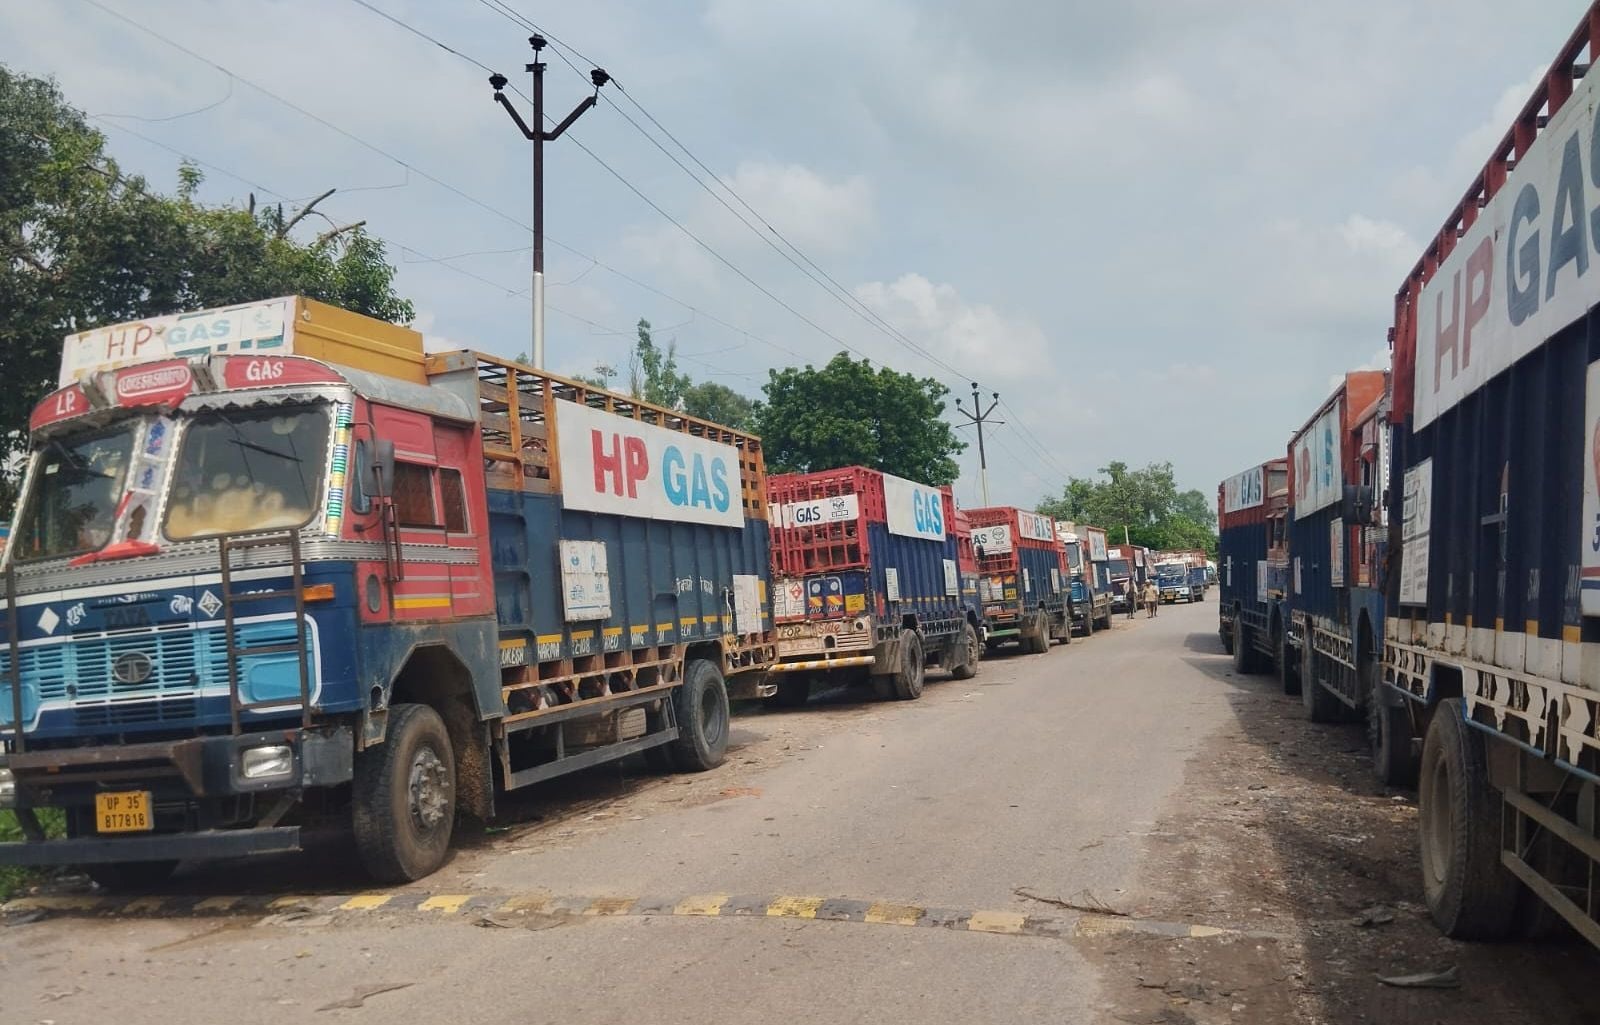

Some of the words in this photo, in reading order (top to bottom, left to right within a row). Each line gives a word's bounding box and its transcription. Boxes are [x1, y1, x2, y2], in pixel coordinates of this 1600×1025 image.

[1434, 235, 1494, 394] HP
[166, 318, 231, 345] GAS
[246, 360, 285, 381] GAS
[591, 428, 650, 499] HP
[662, 444, 730, 513] GAS
[796, 505, 821, 523] GAS
[914, 488, 942, 536] GAS
[973, 532, 988, 545] AS
[104, 606, 151, 627] TATA
[780, 625, 801, 638] FOR
[106, 796, 120, 810] UP
[127, 795, 139, 809] 35
